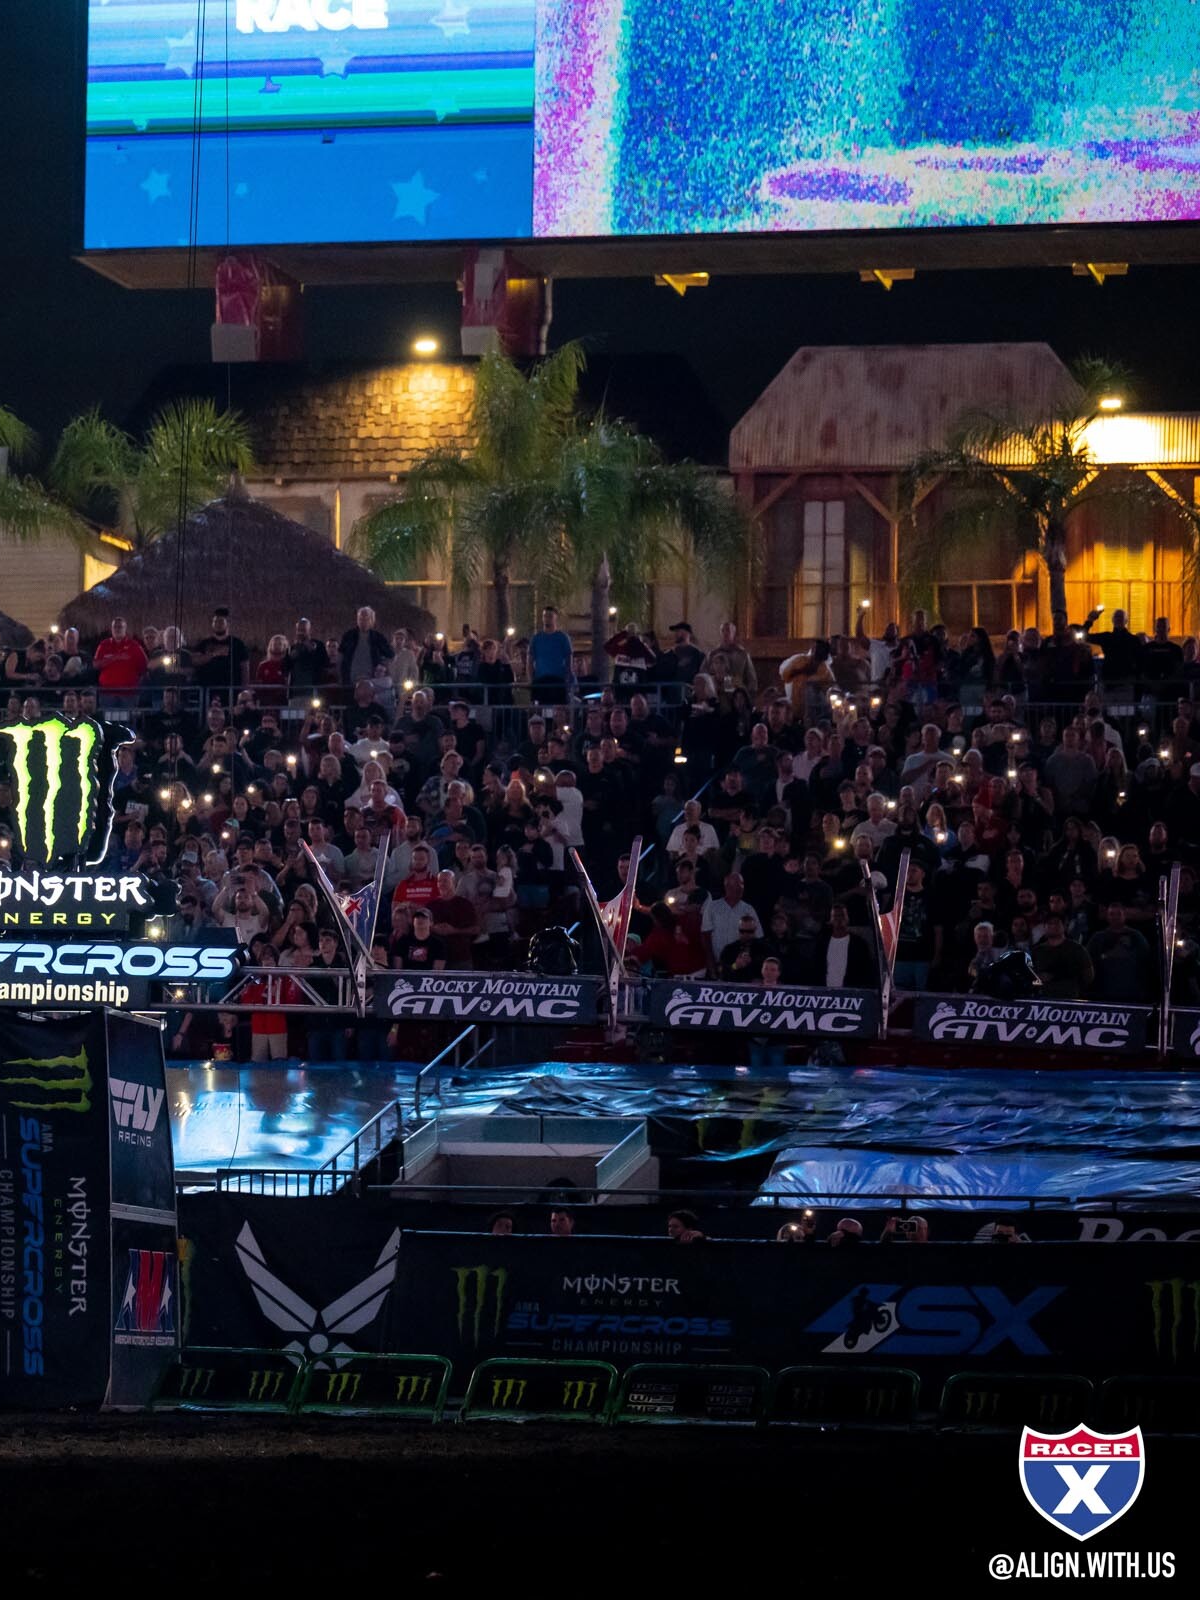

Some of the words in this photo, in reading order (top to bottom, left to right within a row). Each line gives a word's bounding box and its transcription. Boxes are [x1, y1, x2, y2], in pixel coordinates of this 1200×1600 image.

[109, 1077, 165, 1132] FLY
[41, 1124, 56, 1153] AMA
[118, 1130, 152, 1148] RACING
[0, 1169, 15, 1320] CHAMPIONSHIP
[19, 1115, 44, 1377] SUPERCROSS
[54, 1198, 64, 1295] ENERGY
[515, 1302, 540, 1313] AMA
[505, 1311, 734, 1337] SUPERCROSS
[552, 1337, 683, 1356] CHAMPIONSHIP
